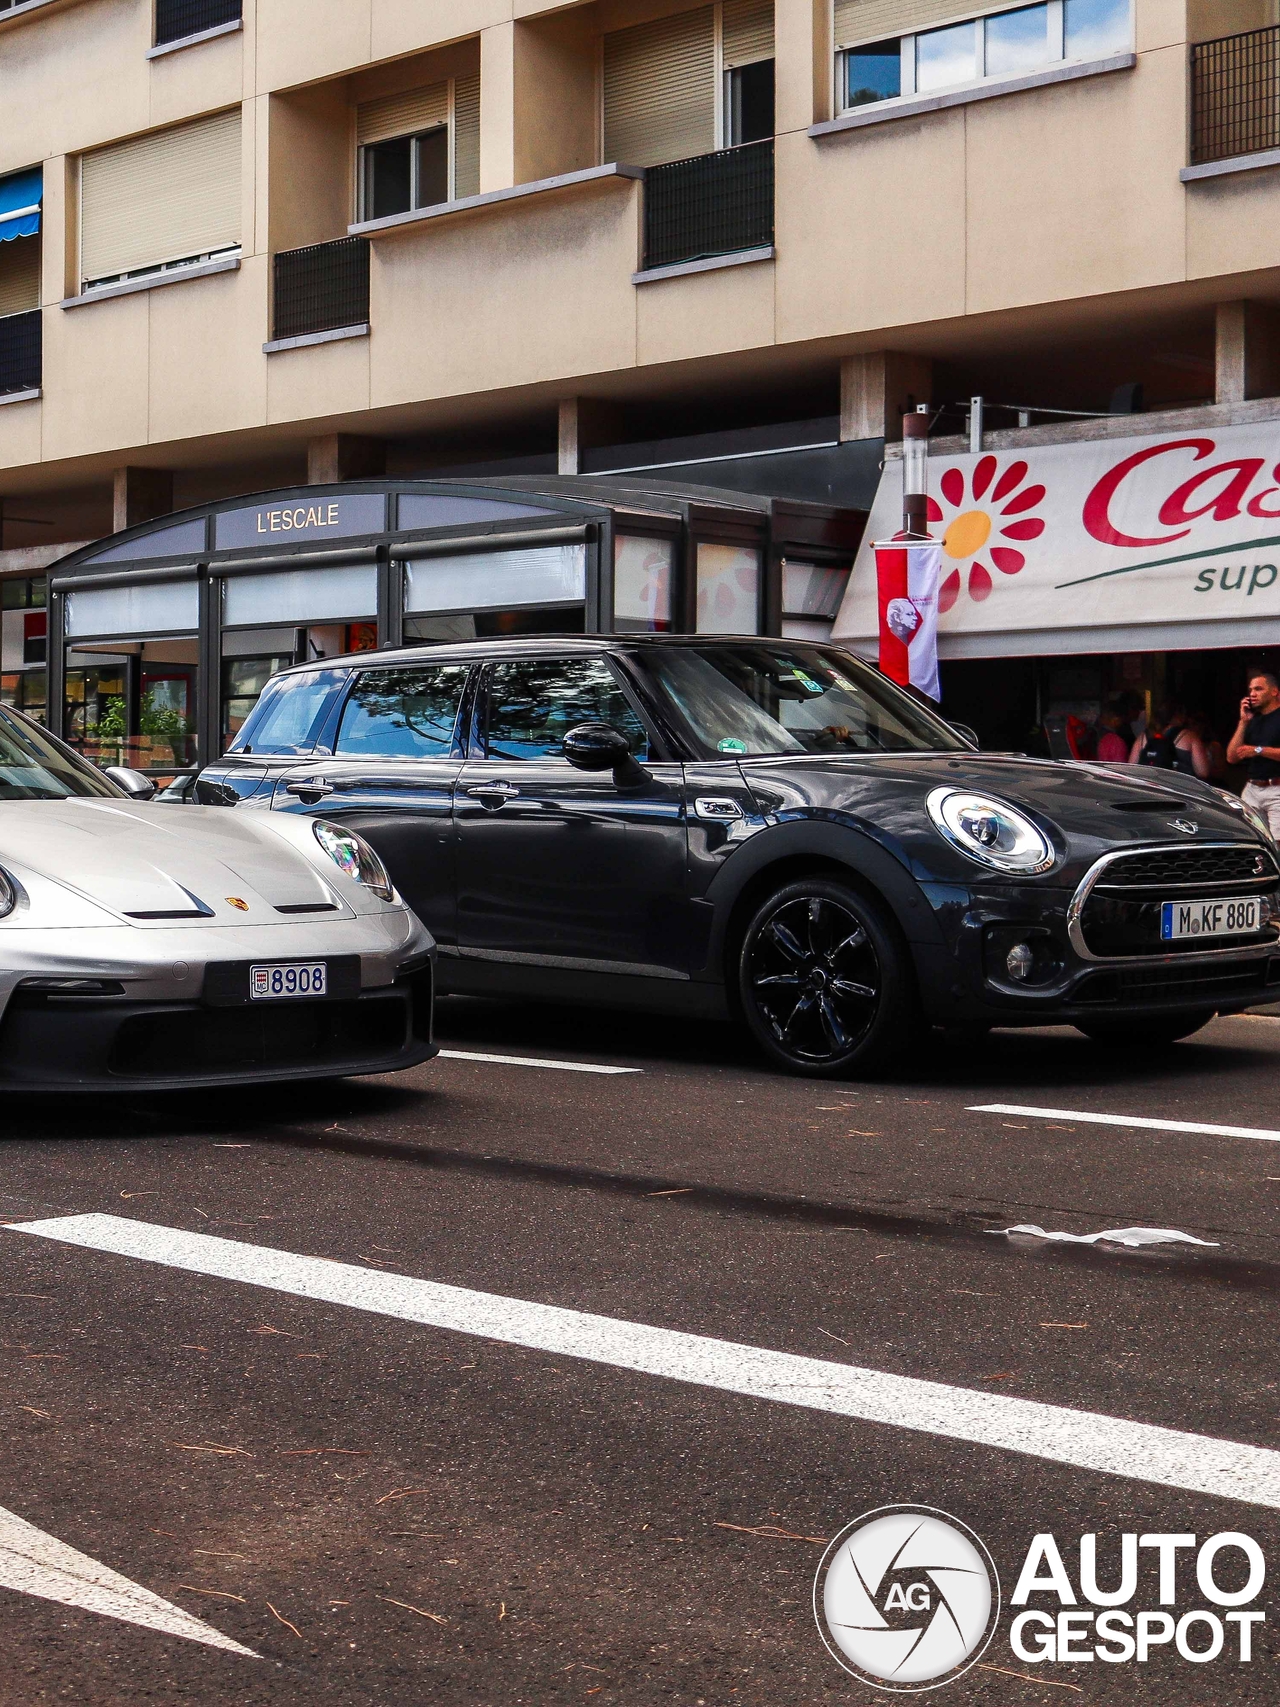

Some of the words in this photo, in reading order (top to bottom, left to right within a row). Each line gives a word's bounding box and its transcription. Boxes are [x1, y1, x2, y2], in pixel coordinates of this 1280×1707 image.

[257, 504, 339, 533] L'ESCALE
[1179, 906, 1191, 933] M
[1201, 904, 1223, 932] KF
[1226, 902, 1255, 930] 880
[272, 967, 323, 993] 8908
